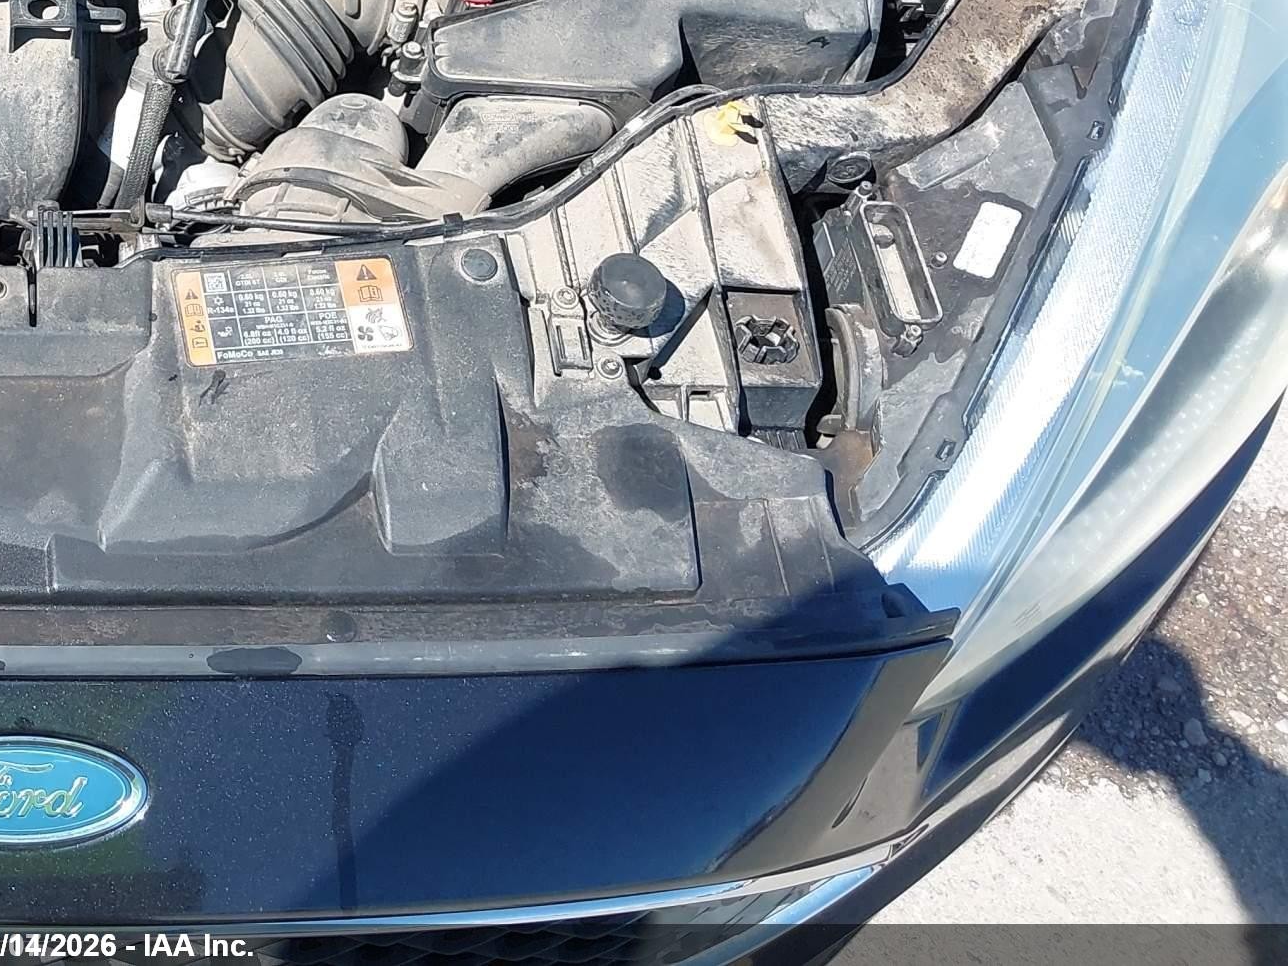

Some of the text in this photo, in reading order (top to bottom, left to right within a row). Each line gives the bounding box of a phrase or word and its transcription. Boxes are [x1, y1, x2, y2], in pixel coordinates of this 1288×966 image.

[288, 290, 298, 299] kg
[326, 288, 336, 297] kg
[255, 293, 264, 302] kg
[280, 335, 296, 344] (120
[218, 351, 254, 360] FoMoCo
